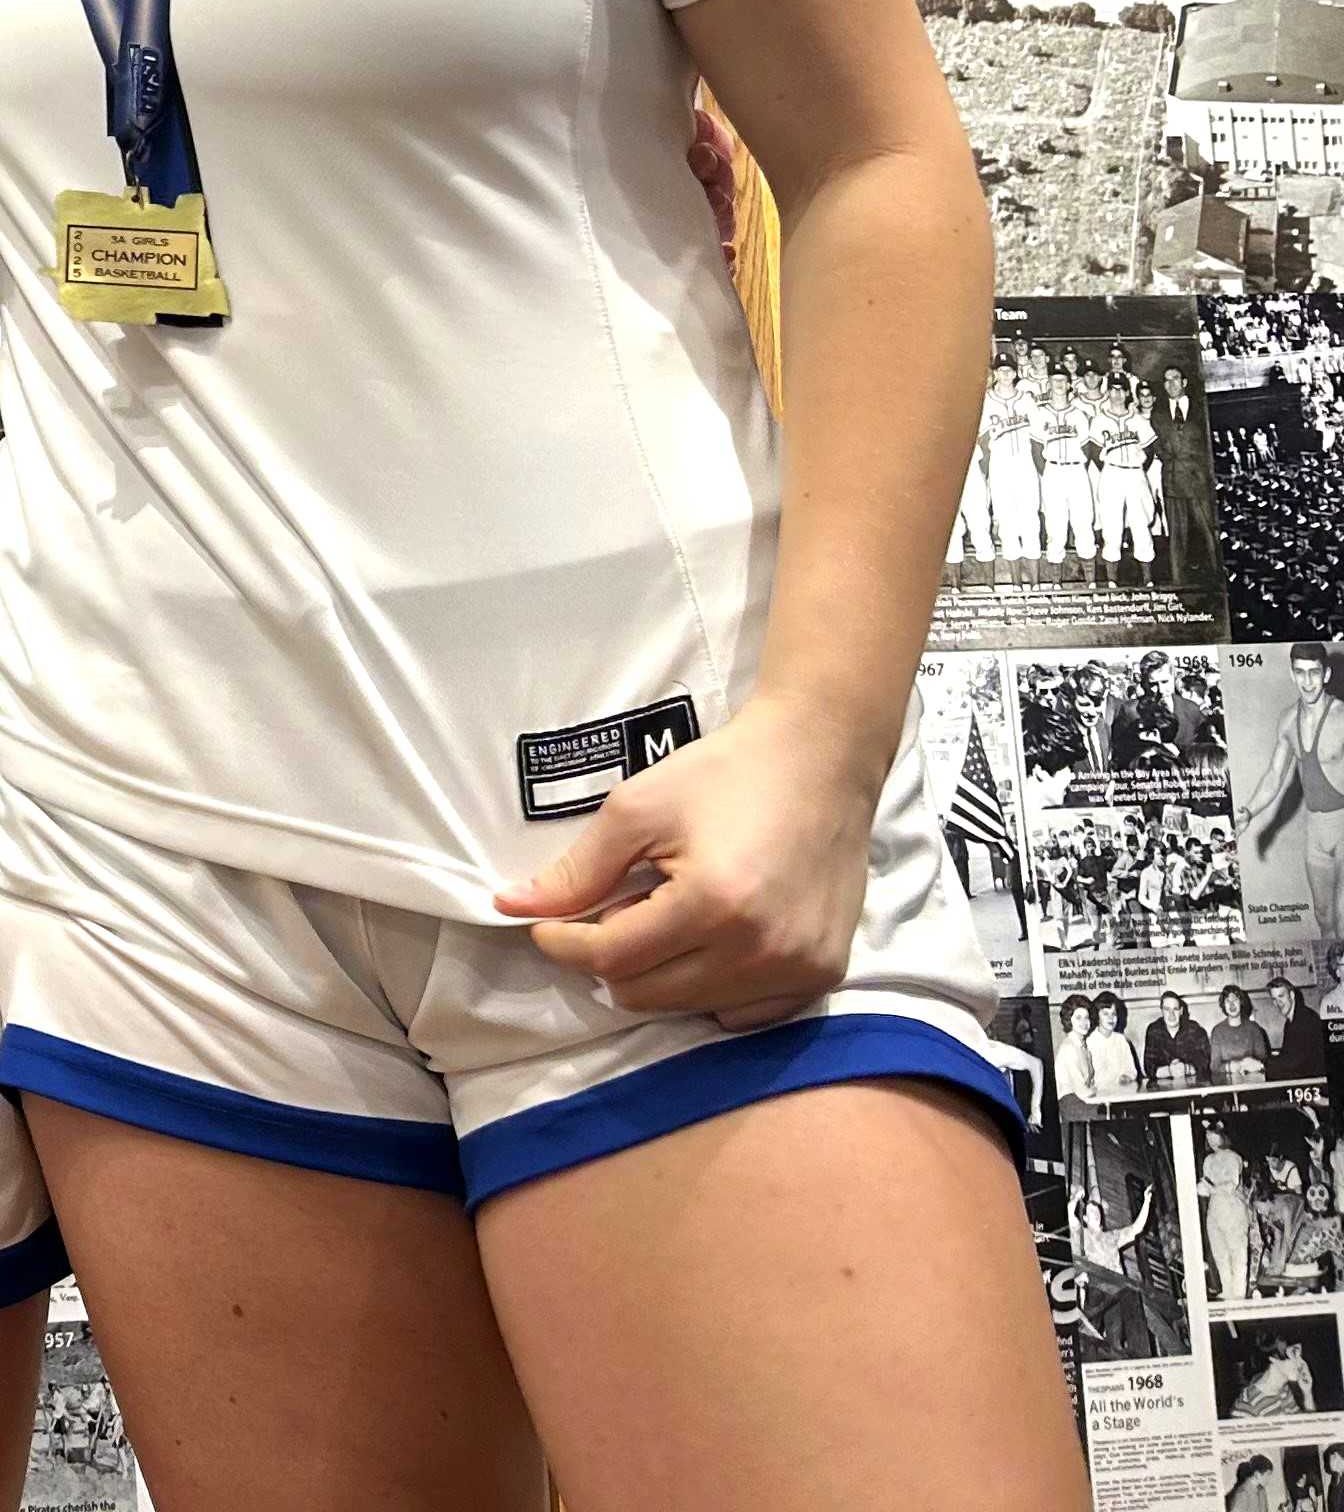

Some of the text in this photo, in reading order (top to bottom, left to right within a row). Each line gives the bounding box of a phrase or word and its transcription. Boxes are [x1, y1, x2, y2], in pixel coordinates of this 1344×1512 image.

[132, 236, 170, 248] GIRLS
[91, 249, 188, 267] CHAMPION
[94, 267, 182, 282] BASKETBALL
[996, 306, 1028, 320] Team
[1174, 654, 1210, 670] 1968
[1228, 653, 1264, 669] 1964
[528, 729, 622, 758] ENGINEERED
[643, 727, 676, 766] M
[1247, 901, 1310, 915] State Champion
[1277, 912, 1302, 924] Smith
[1285, 1087, 1322, 1104] 1963
[1128, 1375, 1164, 1391] 1968
[1089, 1394, 1185, 1414] All the World's
[1092, 1415, 1142, 1432] a Stage
